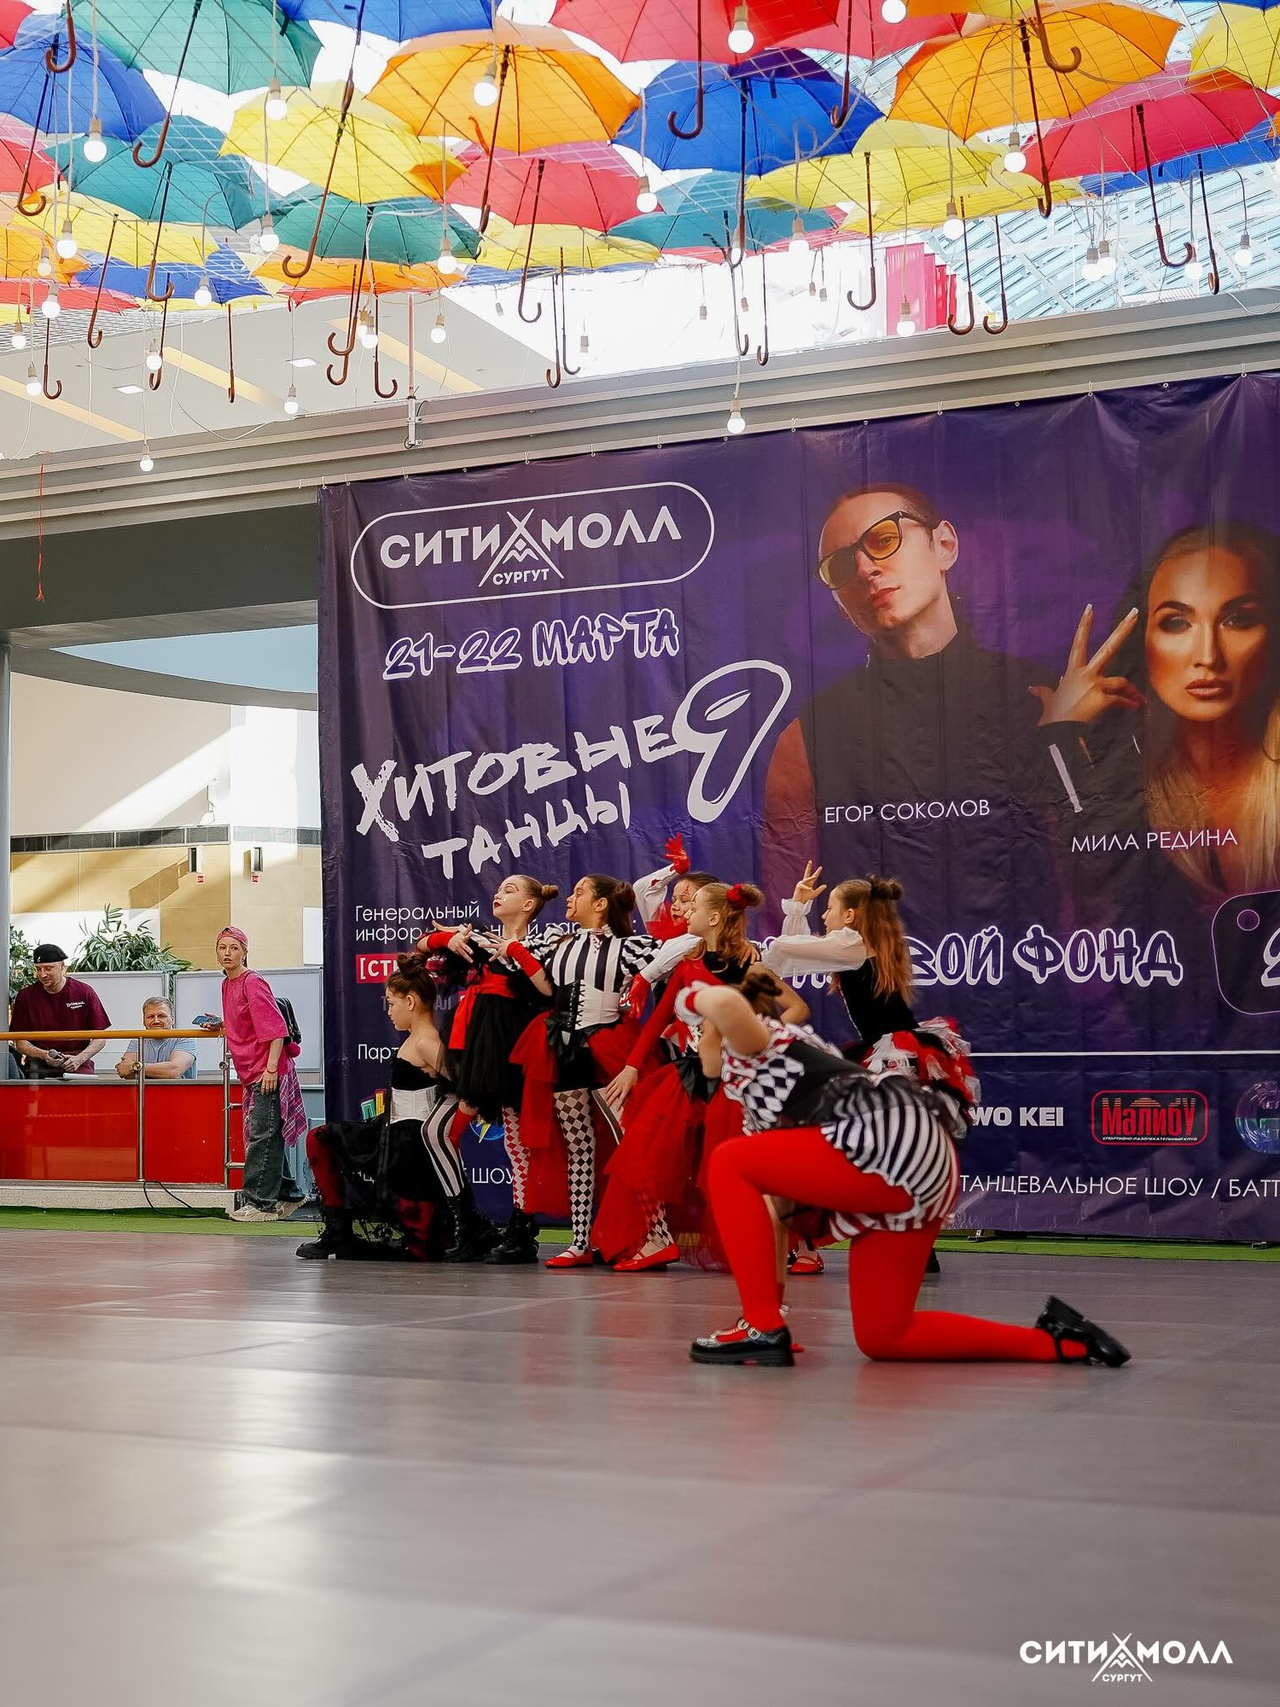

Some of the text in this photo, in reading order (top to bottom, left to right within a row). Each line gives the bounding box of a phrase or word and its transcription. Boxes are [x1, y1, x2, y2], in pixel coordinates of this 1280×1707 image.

[541, 505, 682, 552] МОЛЛ
[492, 568, 550, 586] СУРГУТ
[383, 608, 680, 681] 21-22 МАРТА
[825, 799, 990, 823] ЕГОР СОКОЛОВ
[421, 781, 632, 880] ТАНЦЫ
[1071, 828, 1238, 852] МИЛА РЕДИНА
[355, 900, 480, 925] Генеральный
[1012, 924, 1183, 987] ФОНД
[1019, 1106, 1064, 1127] KEI
[960, 1174, 1137, 1196] ТАНЦЕВАЛЬНОЕ
[1144, 1176, 1203, 1197] ШОУ
